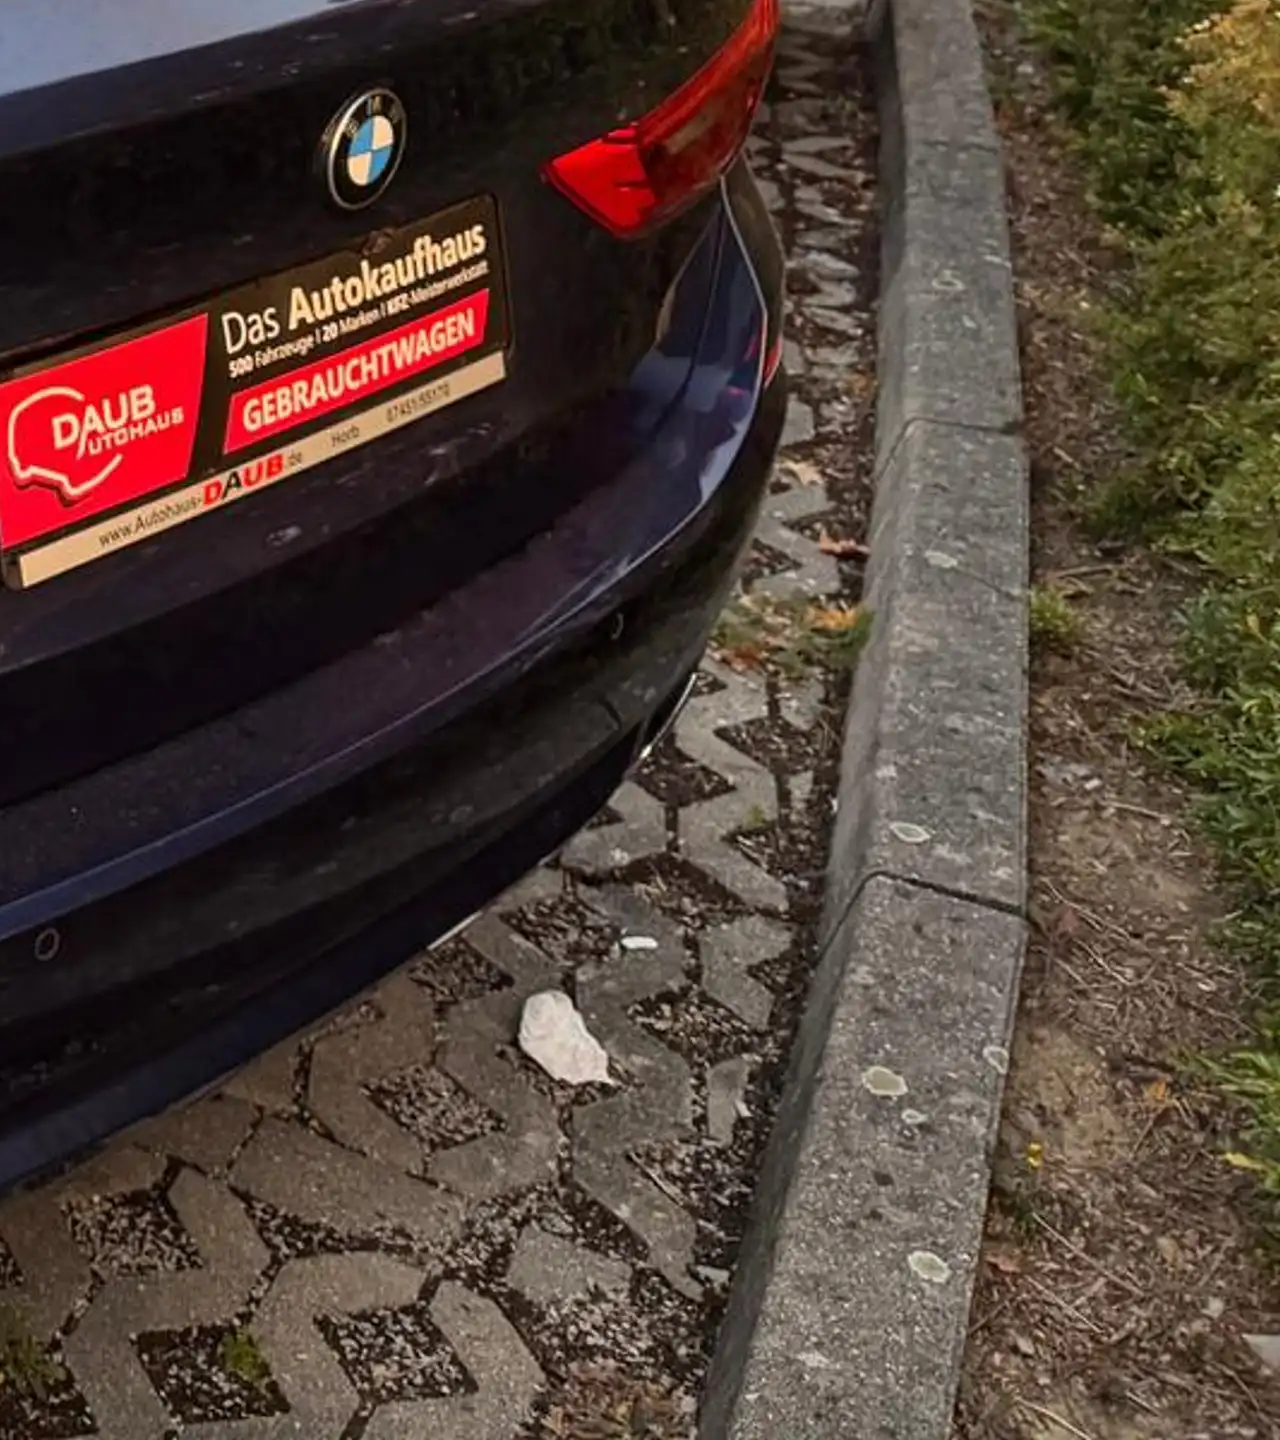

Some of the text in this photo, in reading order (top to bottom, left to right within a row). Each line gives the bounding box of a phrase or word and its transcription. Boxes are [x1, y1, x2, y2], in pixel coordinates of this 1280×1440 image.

[222, 224, 488, 354] Das Autokaufhaus
[321, 322, 339, 342] 20
[242, 308, 475, 433] GEBRAUCHTWAGEN
[52, 383, 157, 459] DAUB
